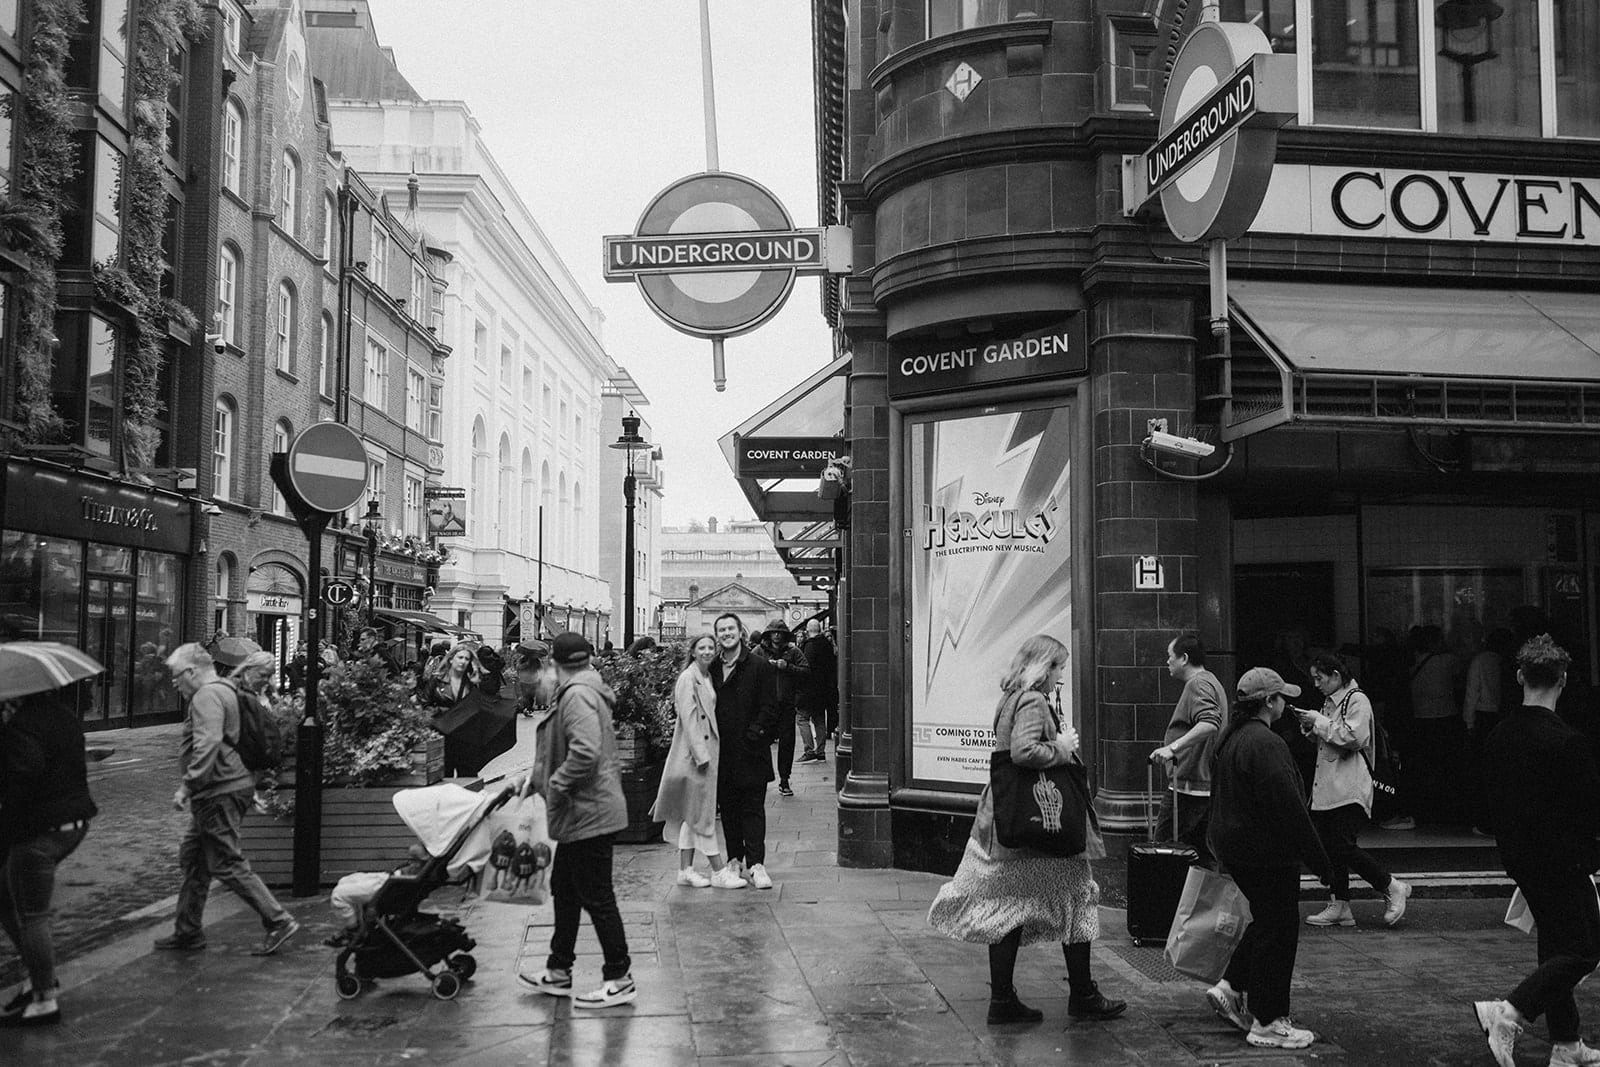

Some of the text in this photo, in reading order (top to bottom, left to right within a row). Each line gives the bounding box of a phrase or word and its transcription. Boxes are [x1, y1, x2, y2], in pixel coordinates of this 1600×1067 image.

[1149, 74, 1254, 186] UNDERGROUND
[615, 237, 815, 266] UNDERGROUND
[900, 333, 1070, 376] COVENT GARDEN
[747, 450, 836, 460] COVENT GARDEN
[935, 544, 1045, 557] THE ELECTRIFYING NEW MUSICAL
[1140, 558, 1159, 585] H
[936, 728, 971, 737] COMING
[974, 730, 985, 738] TO
[960, 738, 997, 748] SUMMER
